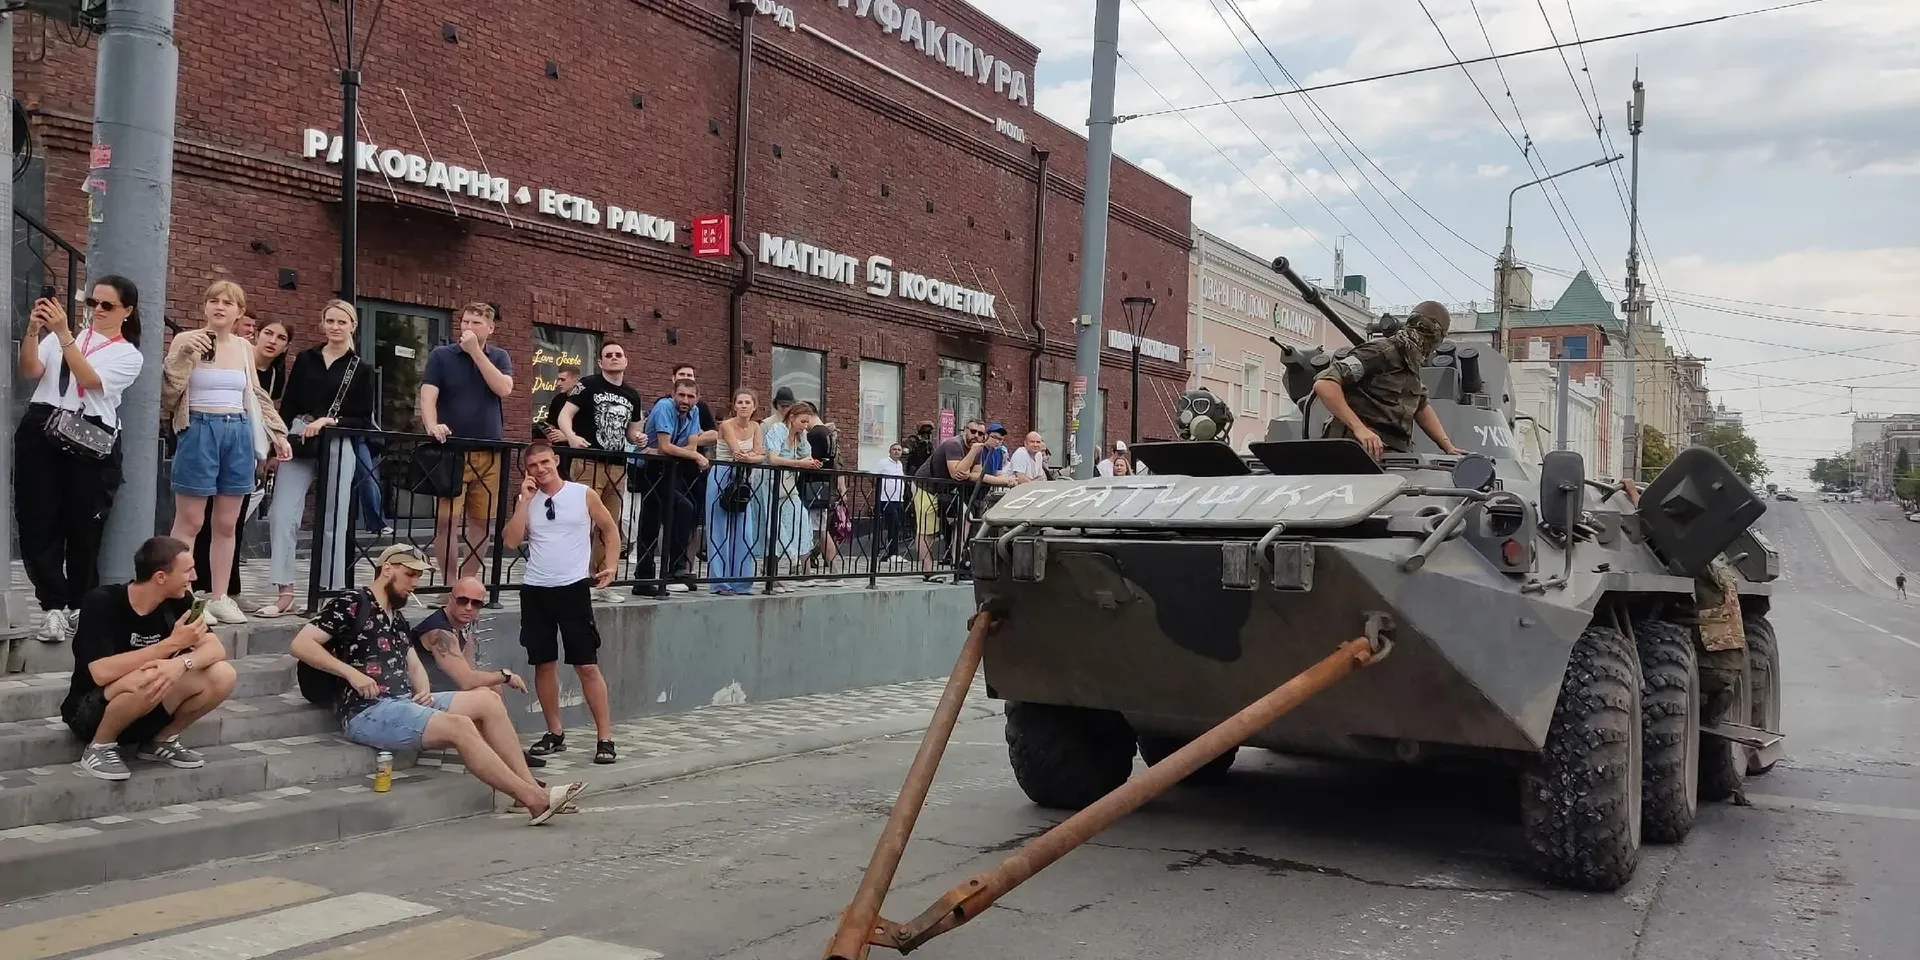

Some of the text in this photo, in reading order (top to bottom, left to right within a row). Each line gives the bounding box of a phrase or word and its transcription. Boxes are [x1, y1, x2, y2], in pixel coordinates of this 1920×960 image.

[838, 0, 1027, 106] УФАКТУРА
[996, 117, 1025, 143] МОЛЛ
[304, 128, 675, 243] РАКОВАРНЯ ЕСТЬ РАКИ
[759, 232, 996, 318] МАГНИТ КОСМЕТИК
[1202, 274, 1270, 320] ОВАРЫ ДЛЯ ДОМА
[1004, 483, 1354, 510] БРАТИШКА
